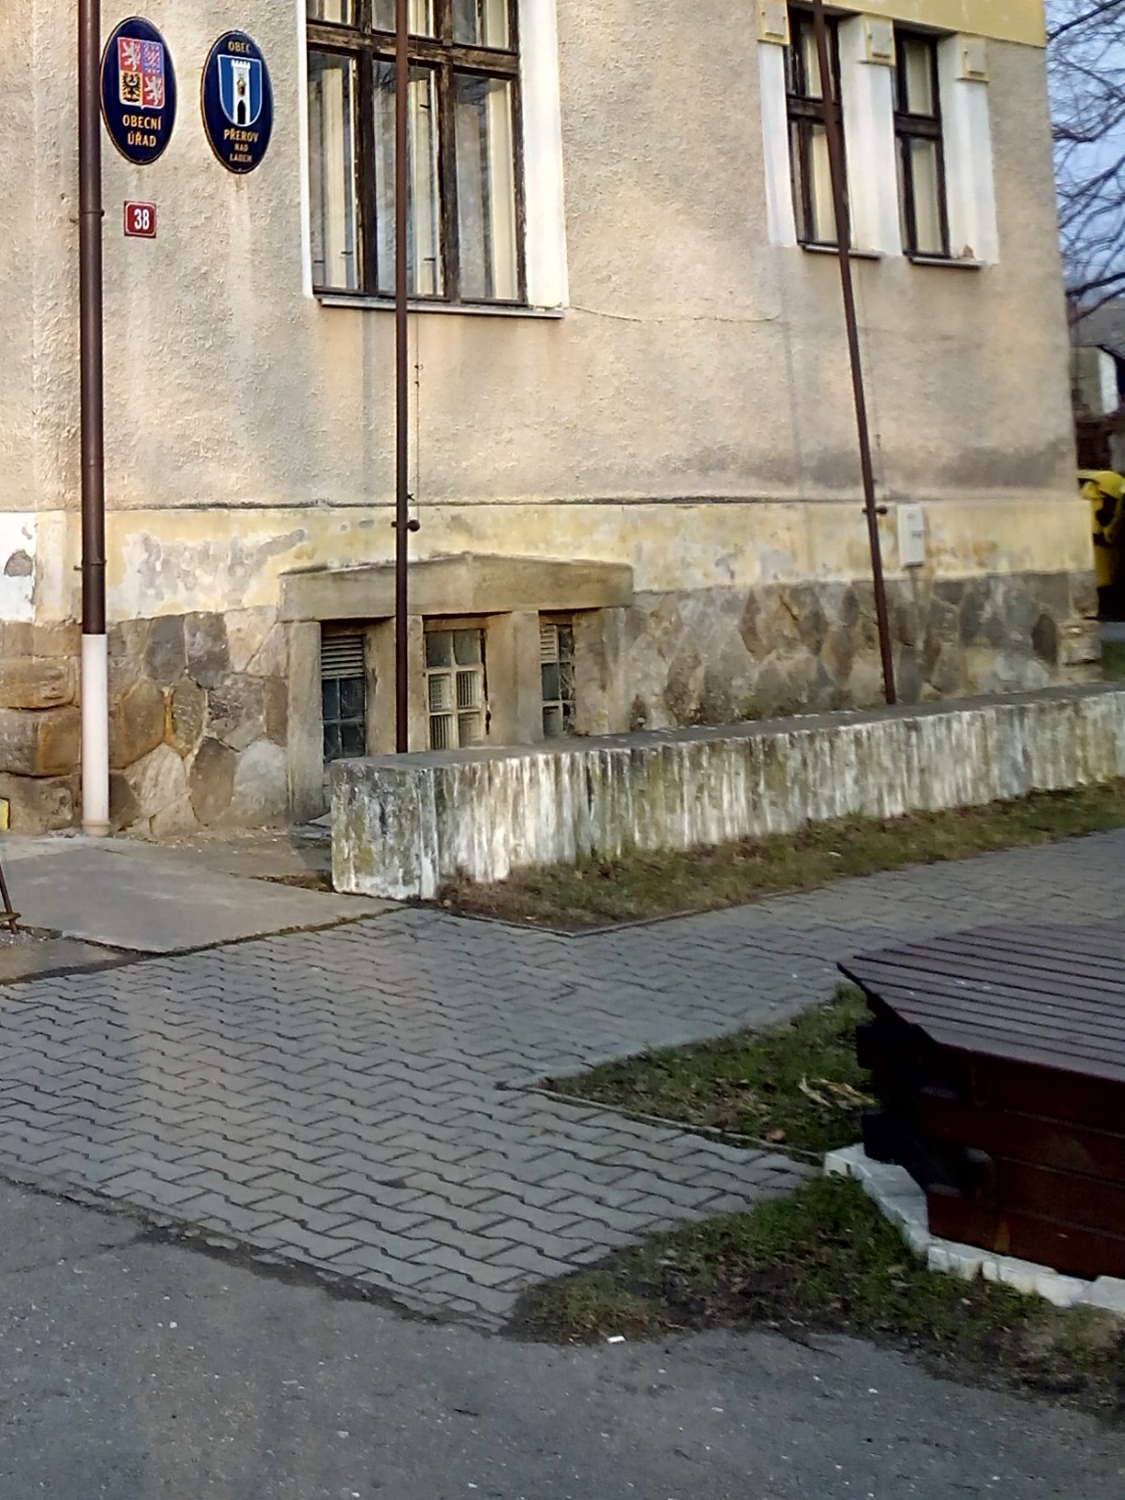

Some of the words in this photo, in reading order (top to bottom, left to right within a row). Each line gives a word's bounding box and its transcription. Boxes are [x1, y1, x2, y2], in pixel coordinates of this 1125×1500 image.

[228, 41, 251, 54] OBEC
[122, 114, 162, 130] OBECNÍ
[127, 131, 157, 147] ÚŘAD
[134, 208, 150, 230] 38
